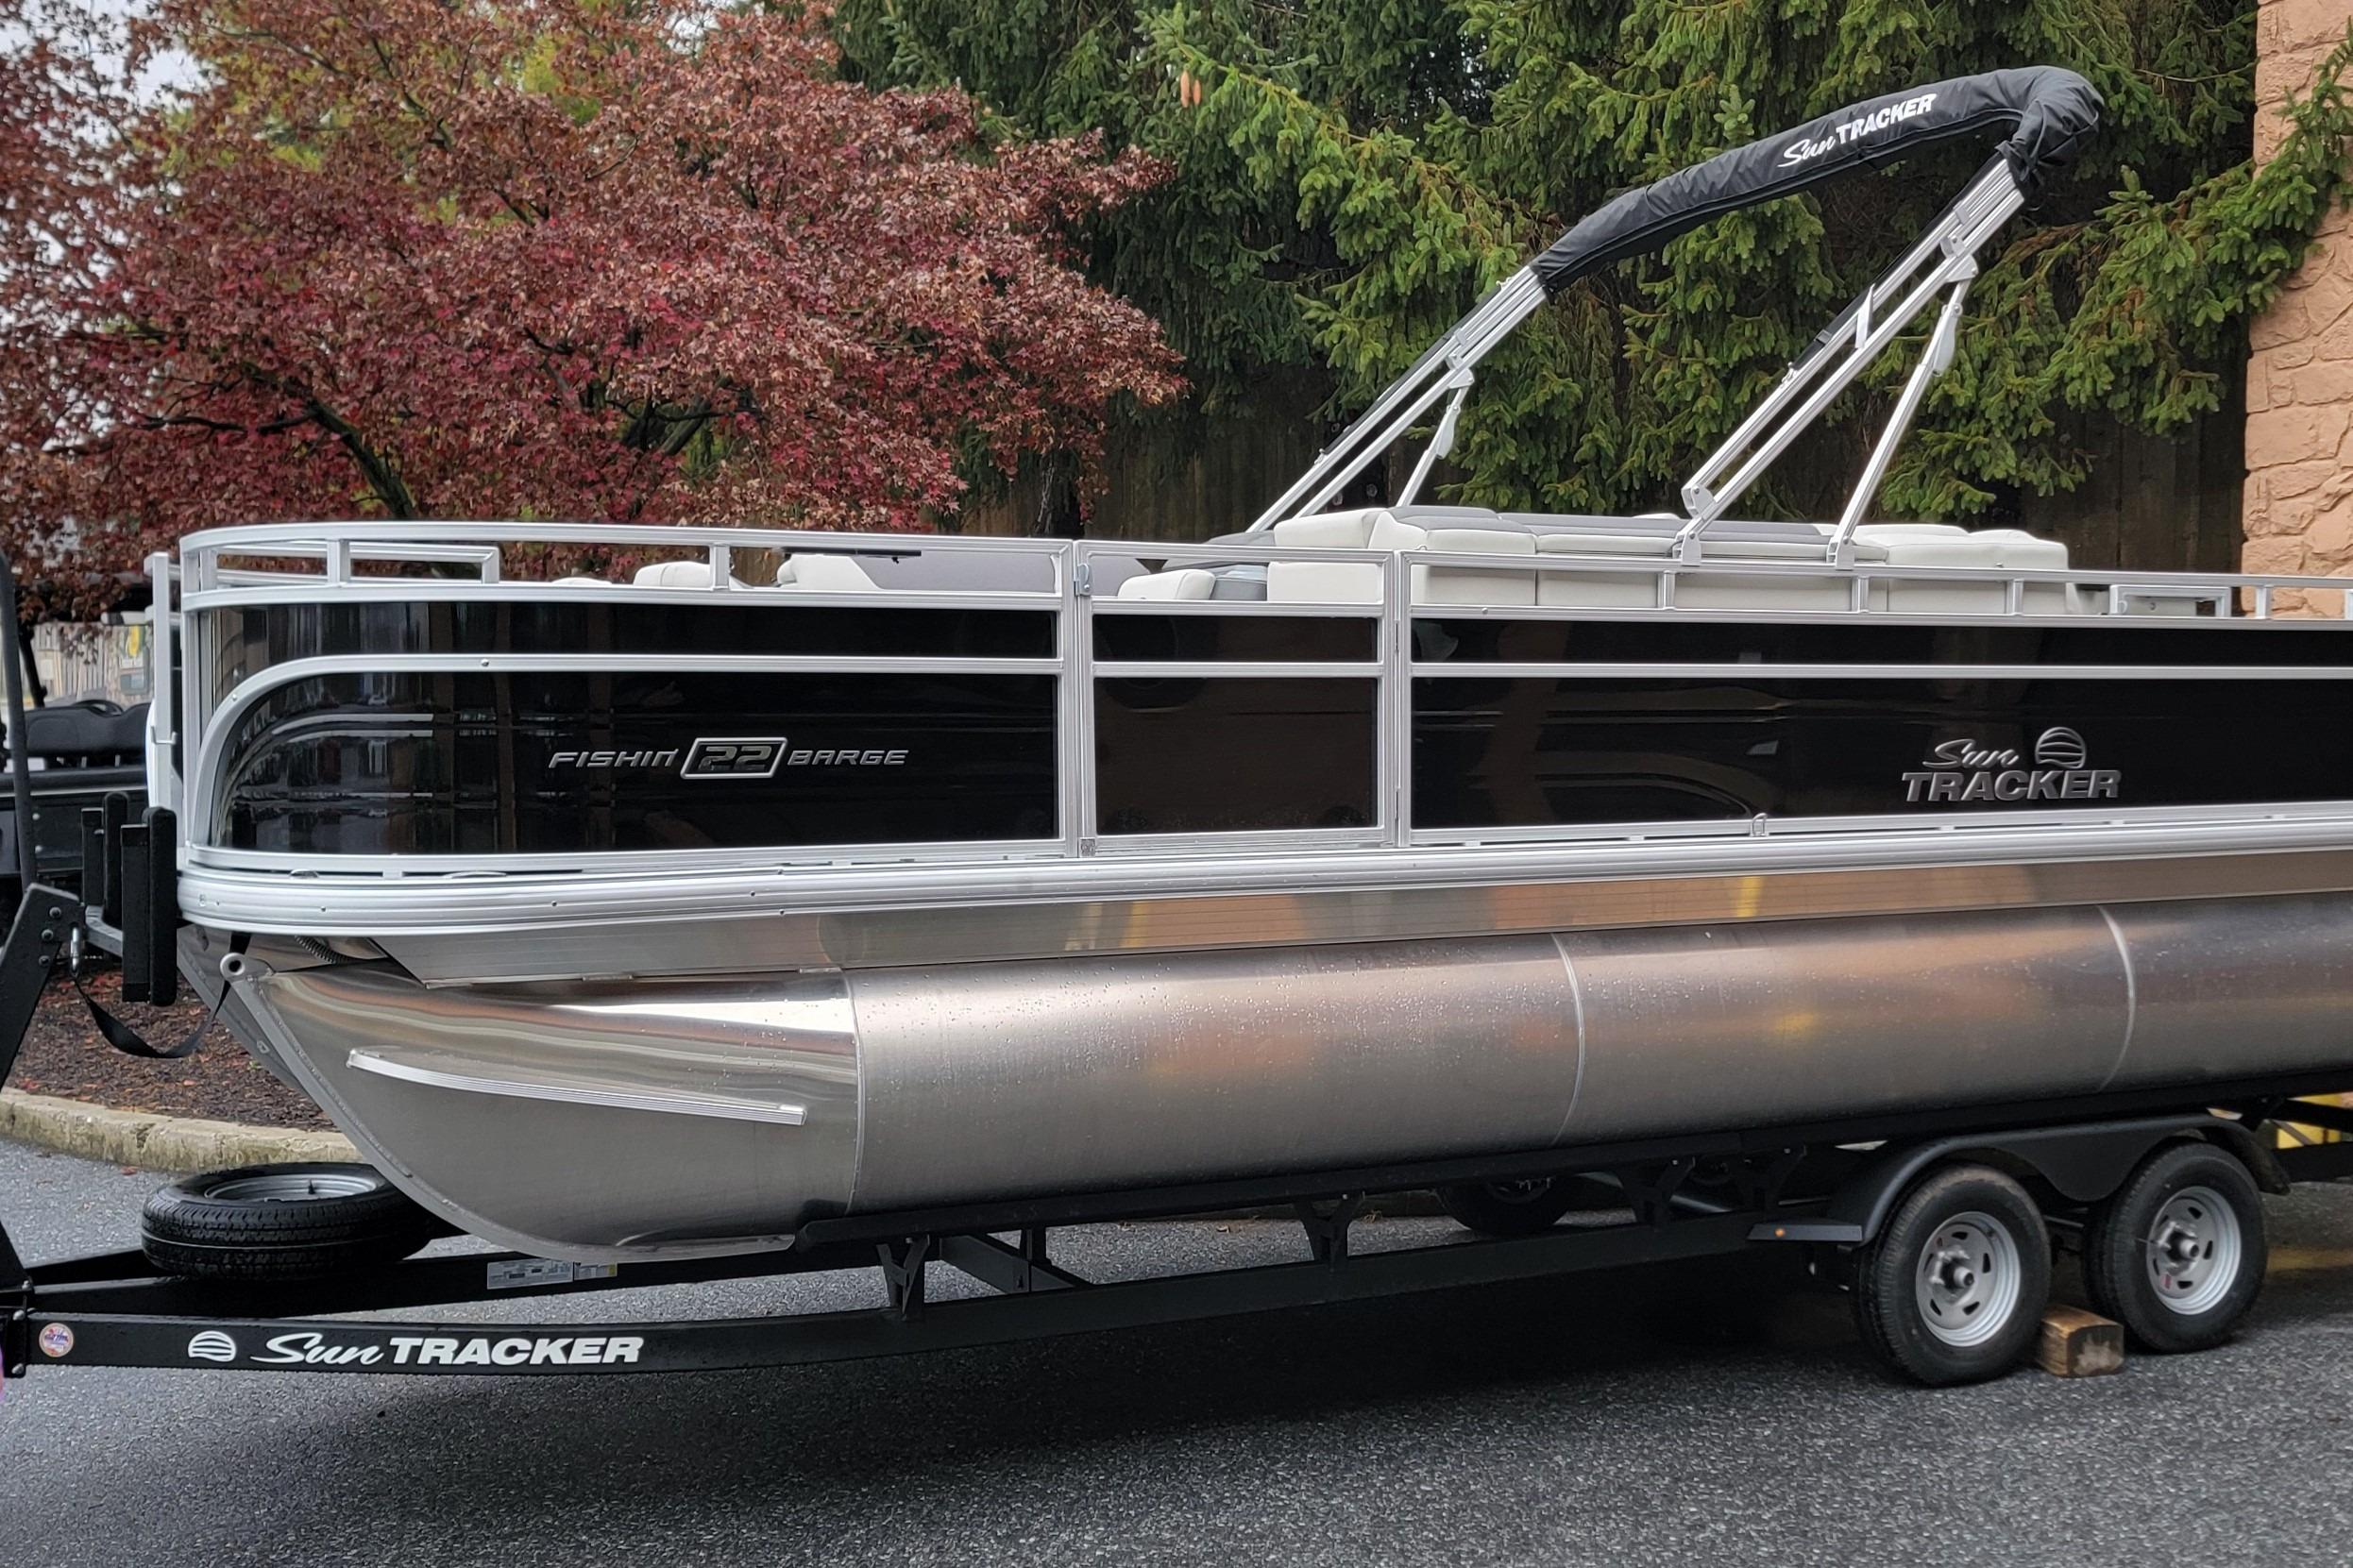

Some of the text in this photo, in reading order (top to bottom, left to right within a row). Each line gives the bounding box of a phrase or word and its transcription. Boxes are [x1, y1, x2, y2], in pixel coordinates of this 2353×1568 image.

[1777, 93, 1937, 168] Sun TRACKER
[698, 745, 772, 771] 22
[787, 750, 909, 766] BARGE
[1921, 738, 2020, 769] Sun
[1901, 769, 2123, 802] TRACKER
[249, 1332, 644, 1366] Sun TRACKER
